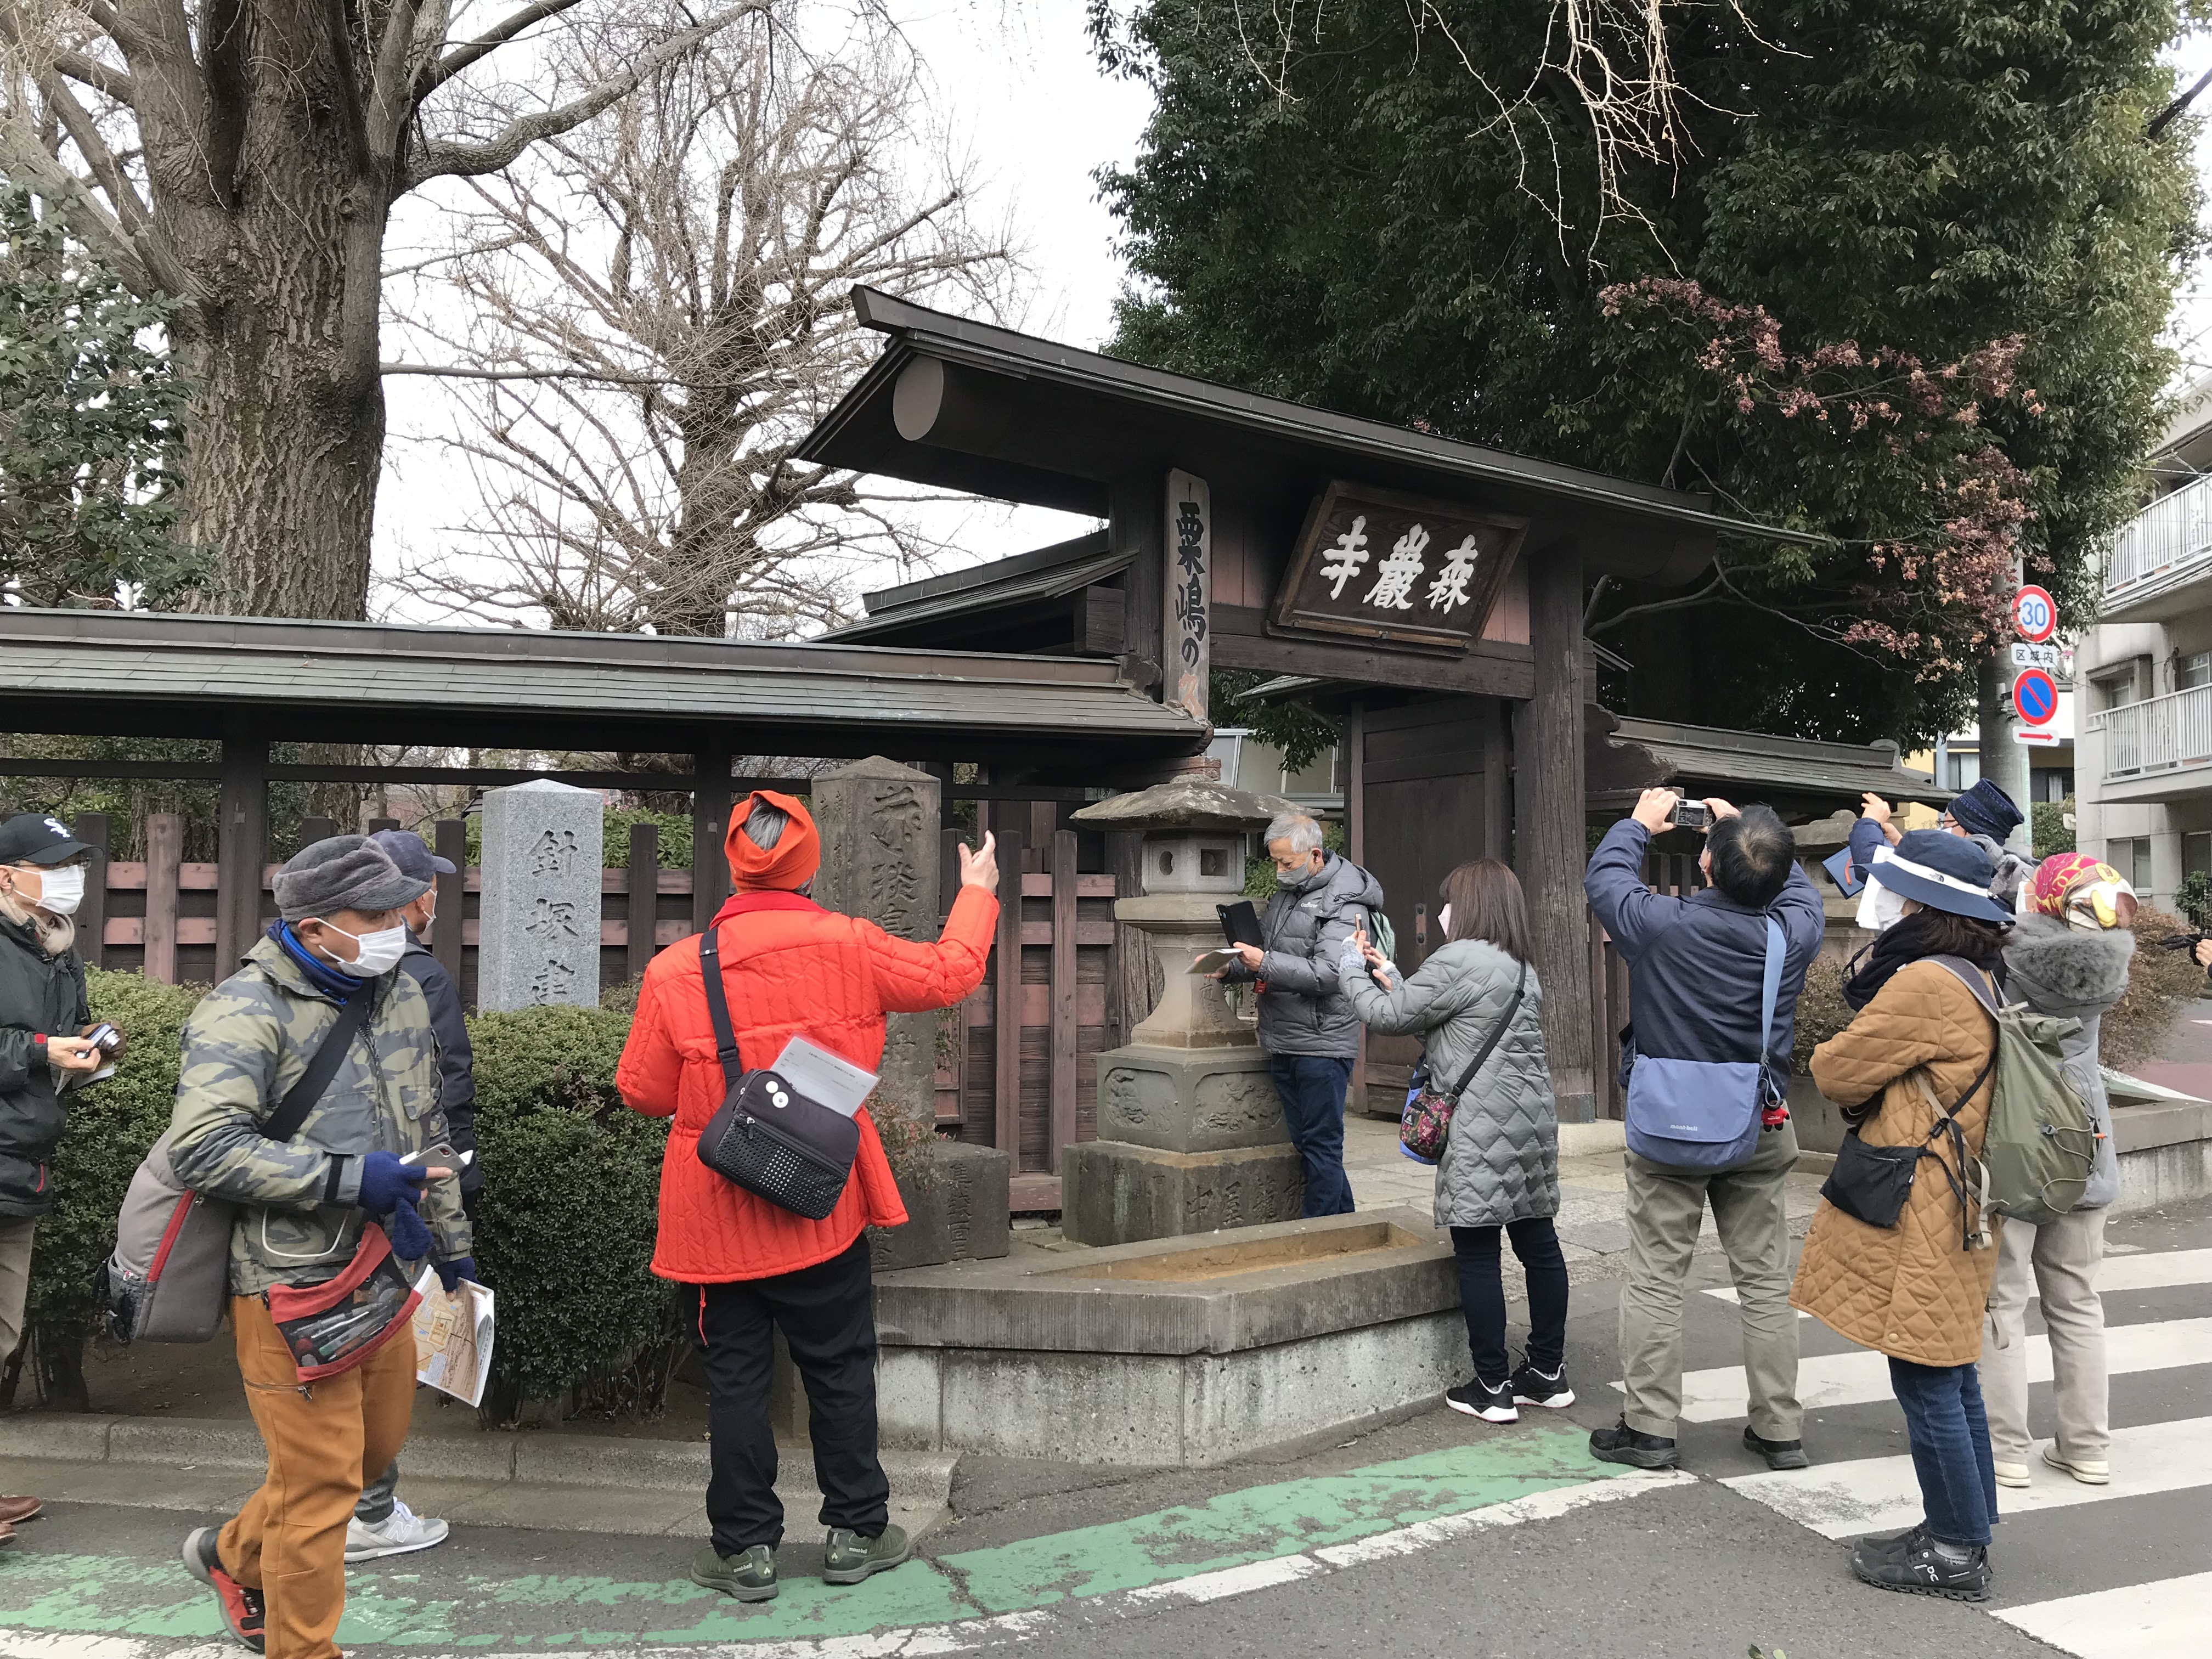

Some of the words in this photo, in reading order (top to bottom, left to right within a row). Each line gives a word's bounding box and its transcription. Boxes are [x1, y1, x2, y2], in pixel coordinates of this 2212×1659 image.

[2022, 601, 2046, 627] 30
[2016, 649, 2053, 664] 区域内
